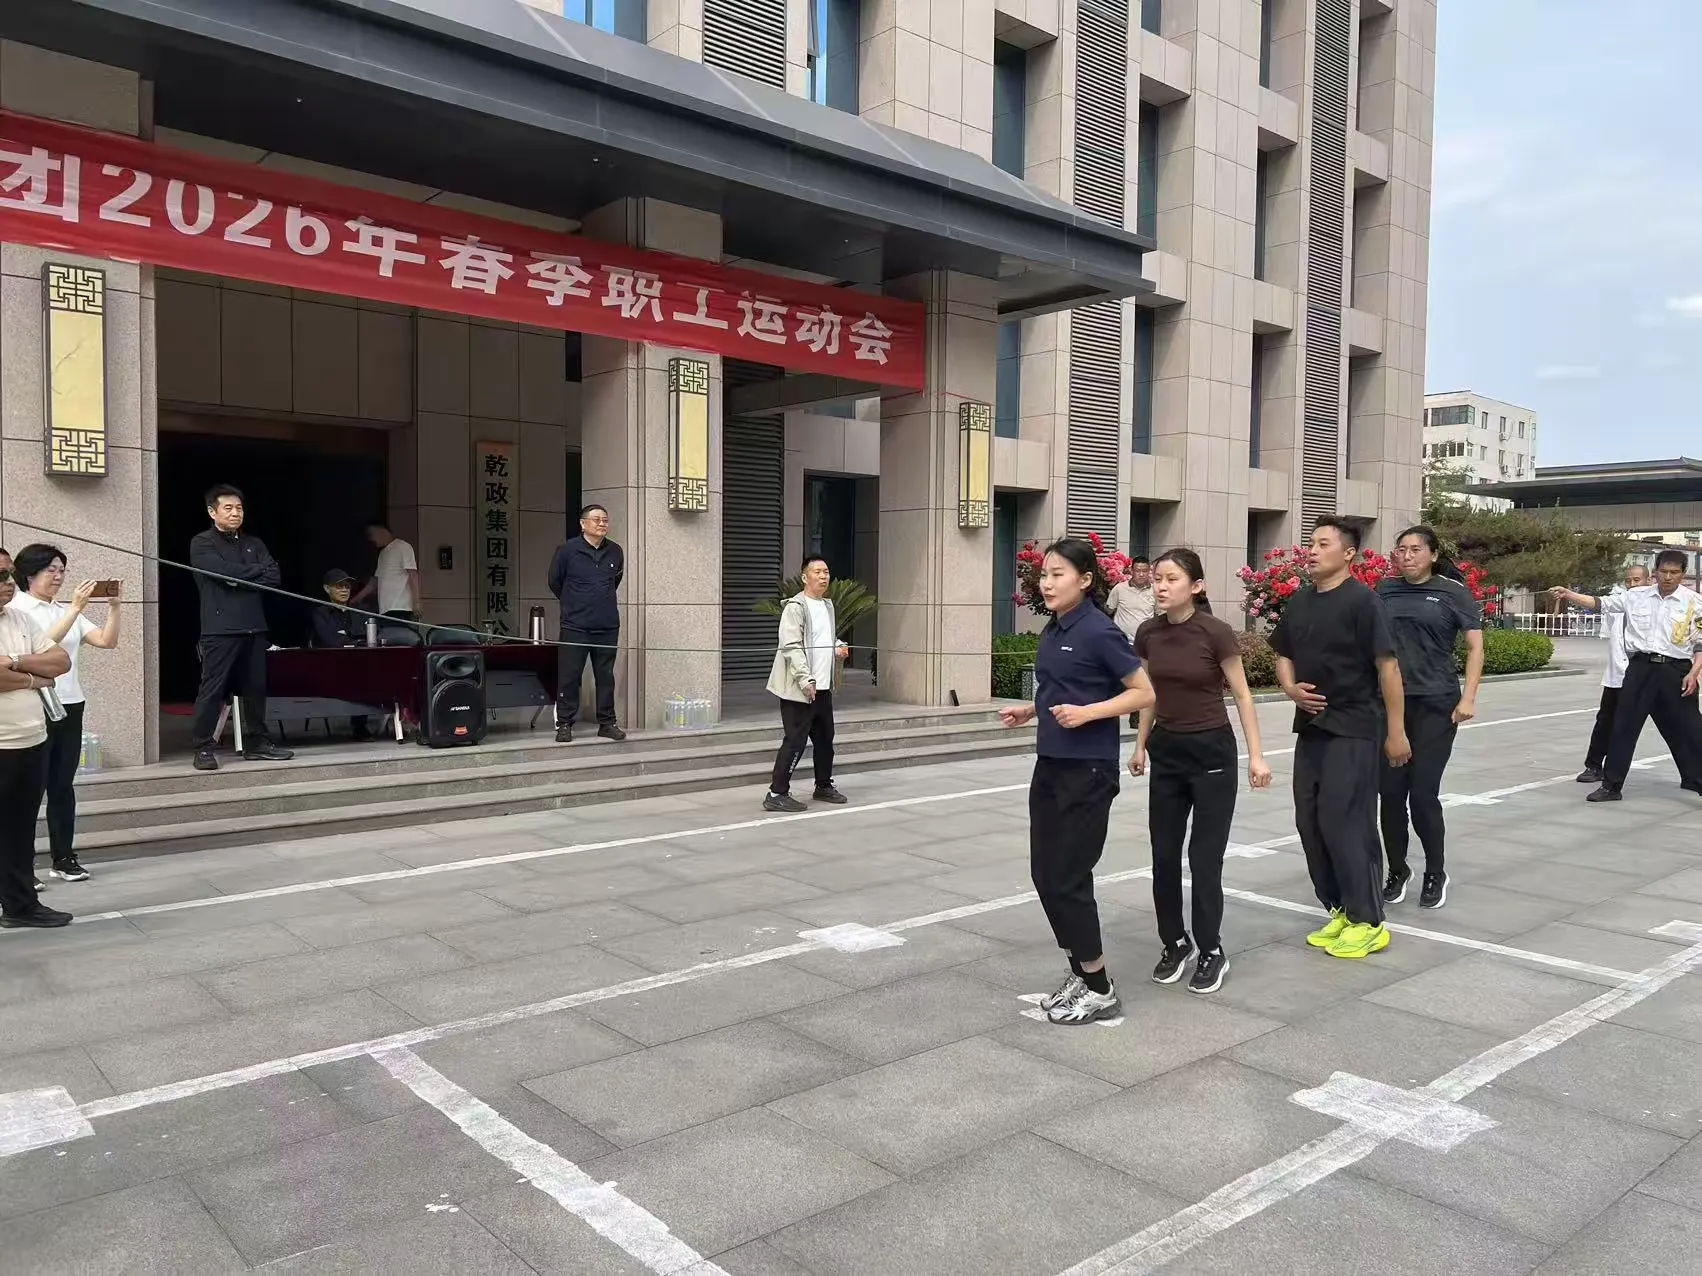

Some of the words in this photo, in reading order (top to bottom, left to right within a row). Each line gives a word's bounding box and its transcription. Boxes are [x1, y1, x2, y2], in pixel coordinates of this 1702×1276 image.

[0, 147, 893, 366] 团2026年春季职工运动会
